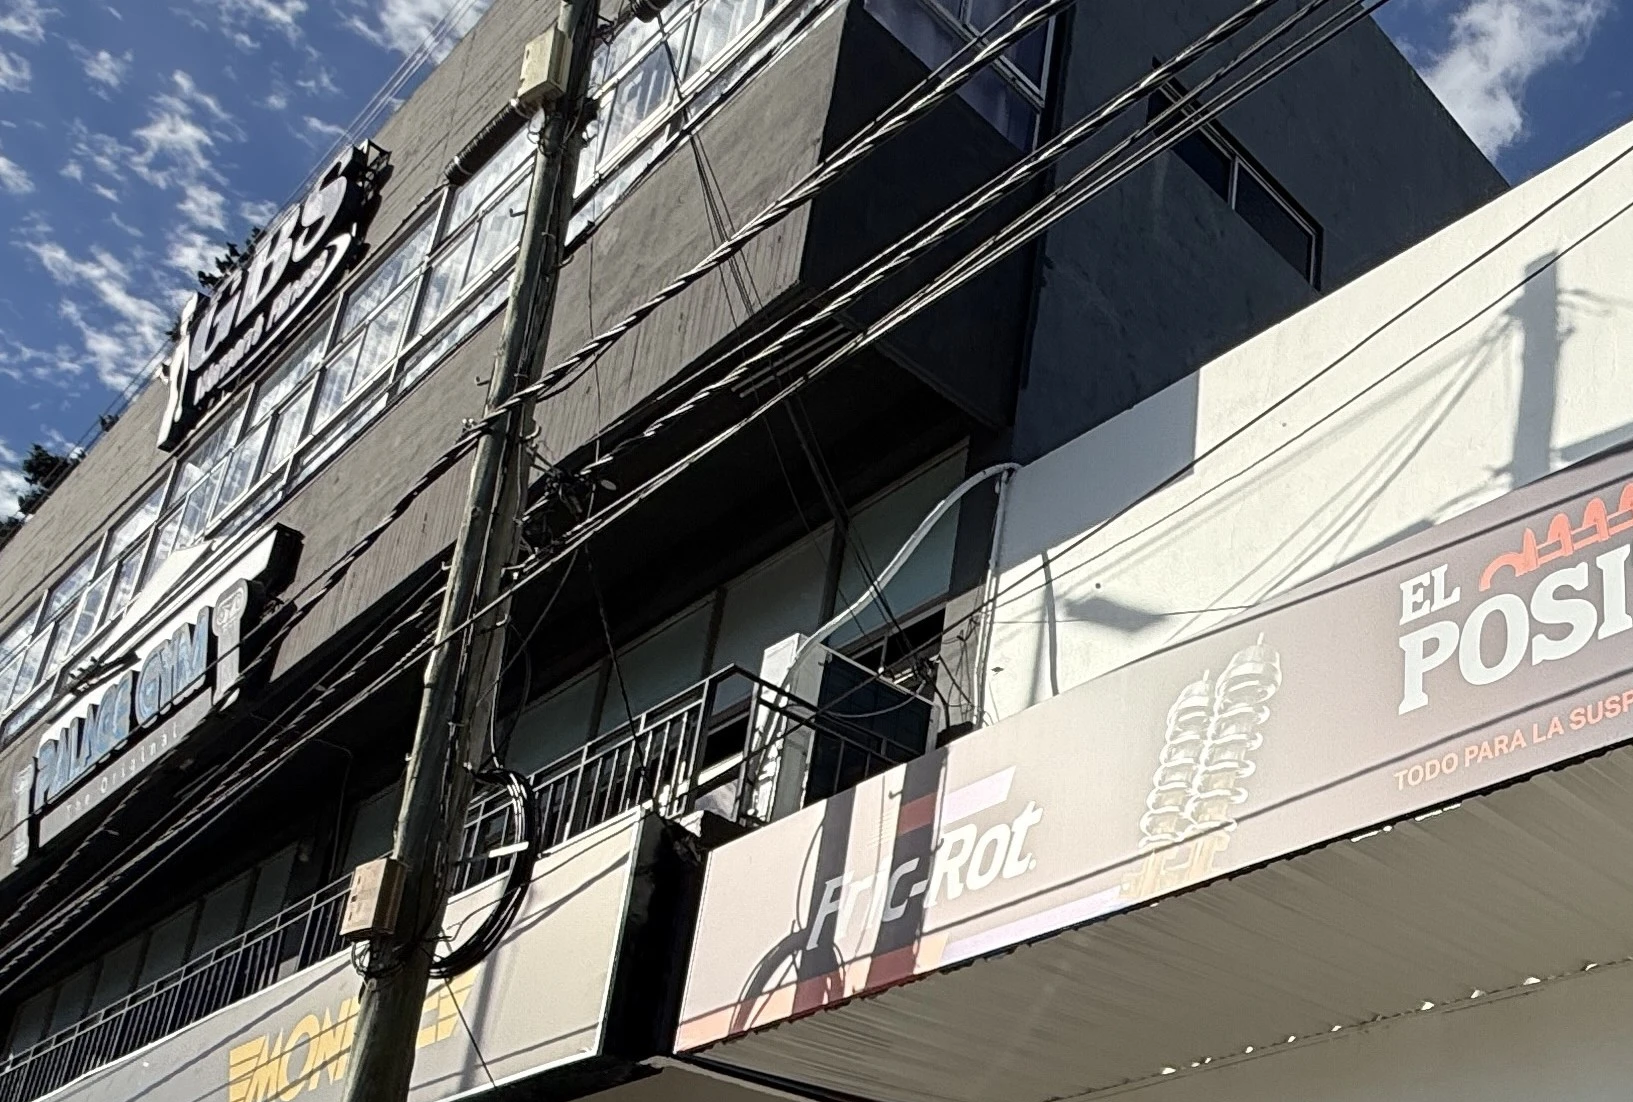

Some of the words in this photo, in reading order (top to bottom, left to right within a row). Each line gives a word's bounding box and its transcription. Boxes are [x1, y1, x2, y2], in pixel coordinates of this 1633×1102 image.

[1400, 563, 1461, 625] EL
[100, 721, 178, 793] Original
[1394, 753, 1459, 792] TODO
[1463, 730, 1527, 768] PARA
[1532, 716, 1564, 746] LA
